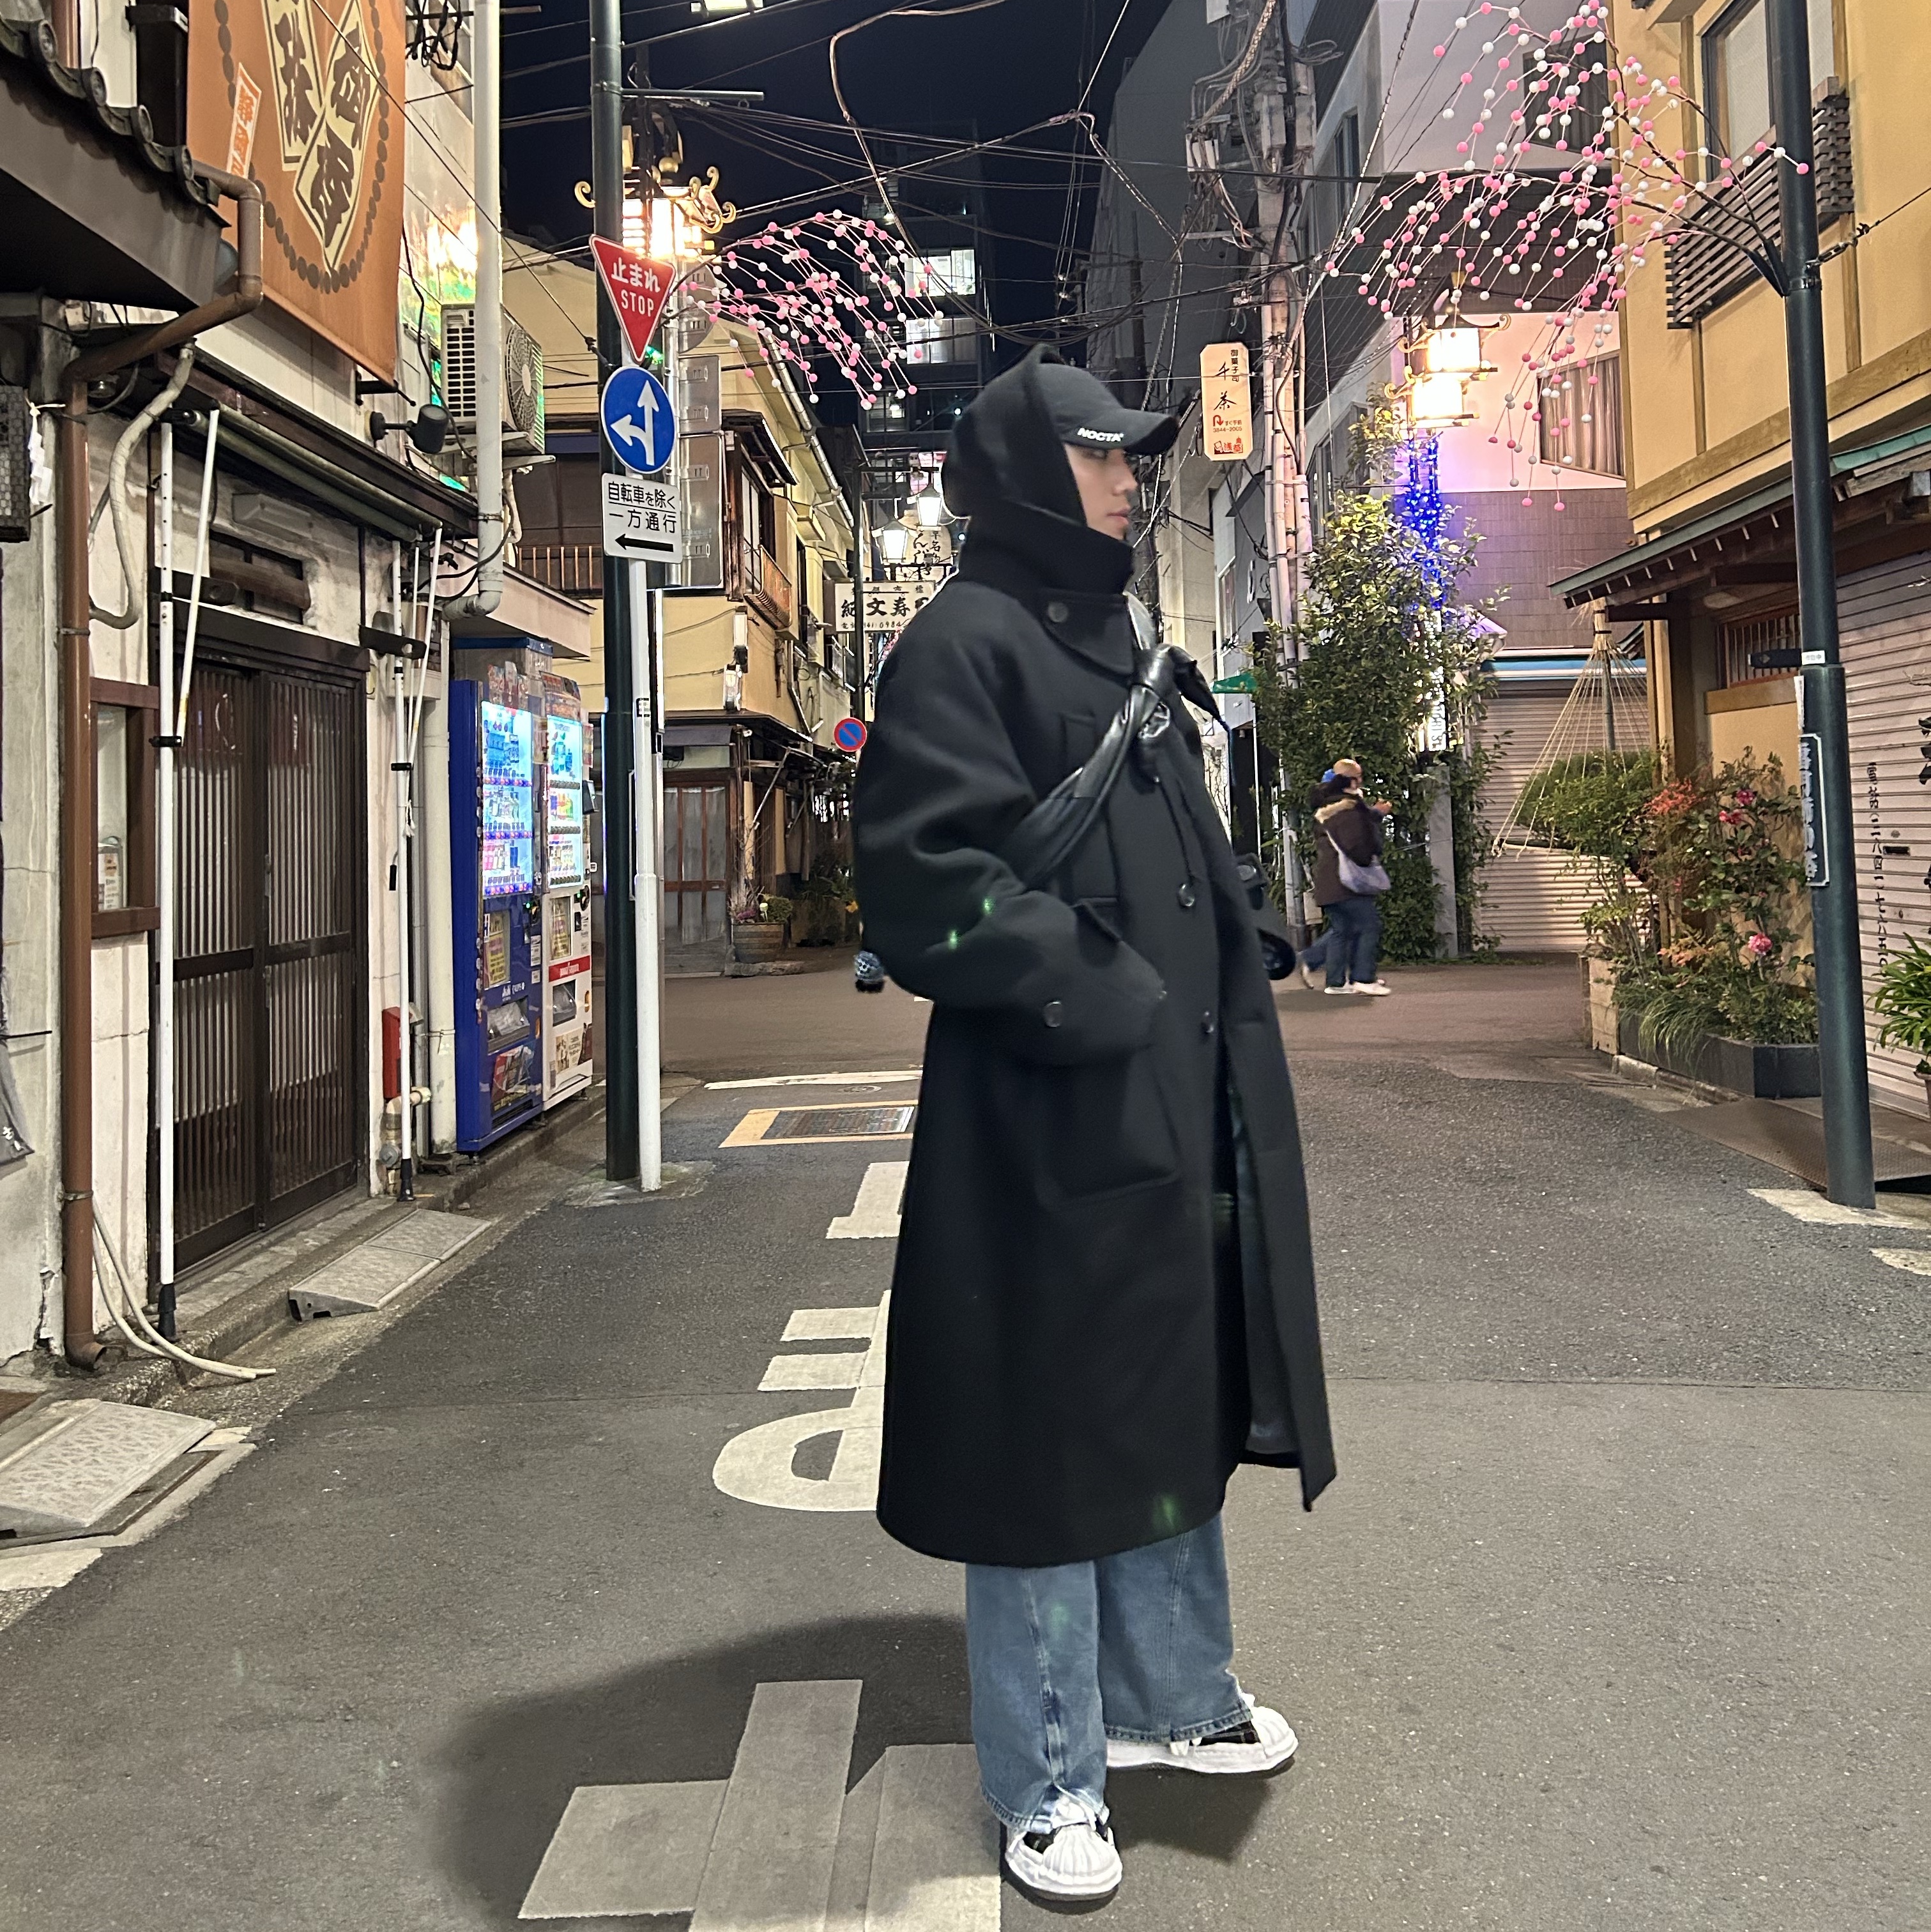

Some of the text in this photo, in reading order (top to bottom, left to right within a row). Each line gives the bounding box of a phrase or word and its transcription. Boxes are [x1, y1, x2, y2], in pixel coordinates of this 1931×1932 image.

[611, 257, 660, 293] 止まれ
[621, 289, 654, 317] STOP
[1231, 349, 1239, 382] 御菓子司
[1077, 427, 1122, 442] NOCTA
[608, 481, 675, 510] 自転車を除く
[609, 509, 677, 533] 一方通行
